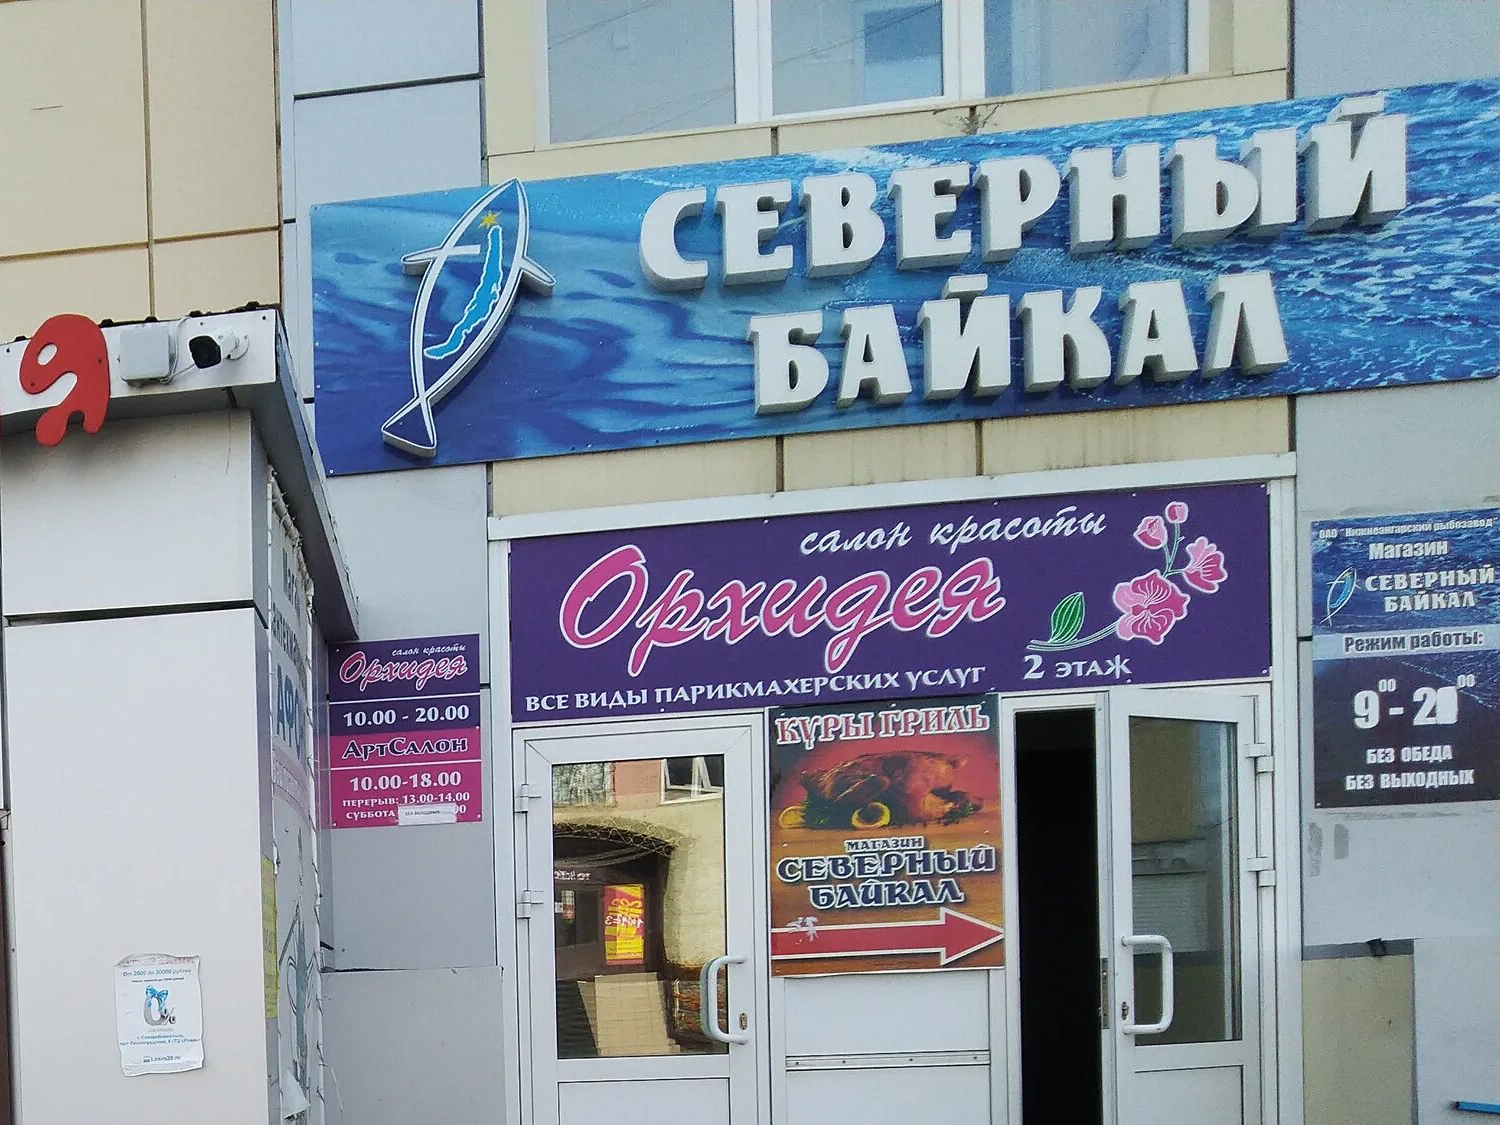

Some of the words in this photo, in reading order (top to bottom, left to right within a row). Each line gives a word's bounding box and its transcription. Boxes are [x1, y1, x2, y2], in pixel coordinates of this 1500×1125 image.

[640, 98, 1407, 291] СЕВЕРНЫЙ
[749, 272, 1290, 416] БАЙКАЛ
[800, 521, 912, 556] салон
[929, 505, 1107, 555] красоты
[1319, 528, 1338, 539] ОАО
[1368, 540, 1448, 560] Магазин
[1365, 564, 1495, 592] СЕВЕРНЫЙ
[558, 544, 1006, 677] Орхидея
[1384, 590, 1477, 613] БАЙКАЛ
[392, 647, 419, 657] салон
[422, 643, 466, 656] красоты
[1344, 635, 1406, 653] Режим
[1410, 631, 1484, 651] работы:
[339, 650, 469, 692] Орхидея
[525, 694, 569, 712] ВСЕ
[574, 689, 648, 709] ВИДЫ
[654, 671, 900, 705] ПАРИКМАХЕРСКИХ
[905, 667, 986, 692] УСЛУГ
[1023, 654, 1045, 681] 2
[1055, 654, 1133, 679] ЭТАЖ
[343, 709, 397, 728] 10.00
[414, 704, 470, 723] 20.00
[775, 711, 874, 750] КУРЫ
[879, 704, 990, 738] ГРИЛЬ
[1366, 747, 1396, 765] БЕЗ
[1401, 744, 1453, 764] ОБЕДА
[1345, 774, 1375, 792] БЕЗ
[1380, 769, 1476, 790] ВЫХОДНЫХ
[342, 797, 400, 808] ПЕРЕРЫВ:
[346, 810, 396, 821] СУББОТА
[844, 836, 924, 852] МАГАЗИН
[777, 844, 996, 882] СЕВЕРНЫЙ
[808, 878, 965, 910] БАЙКАЛ
